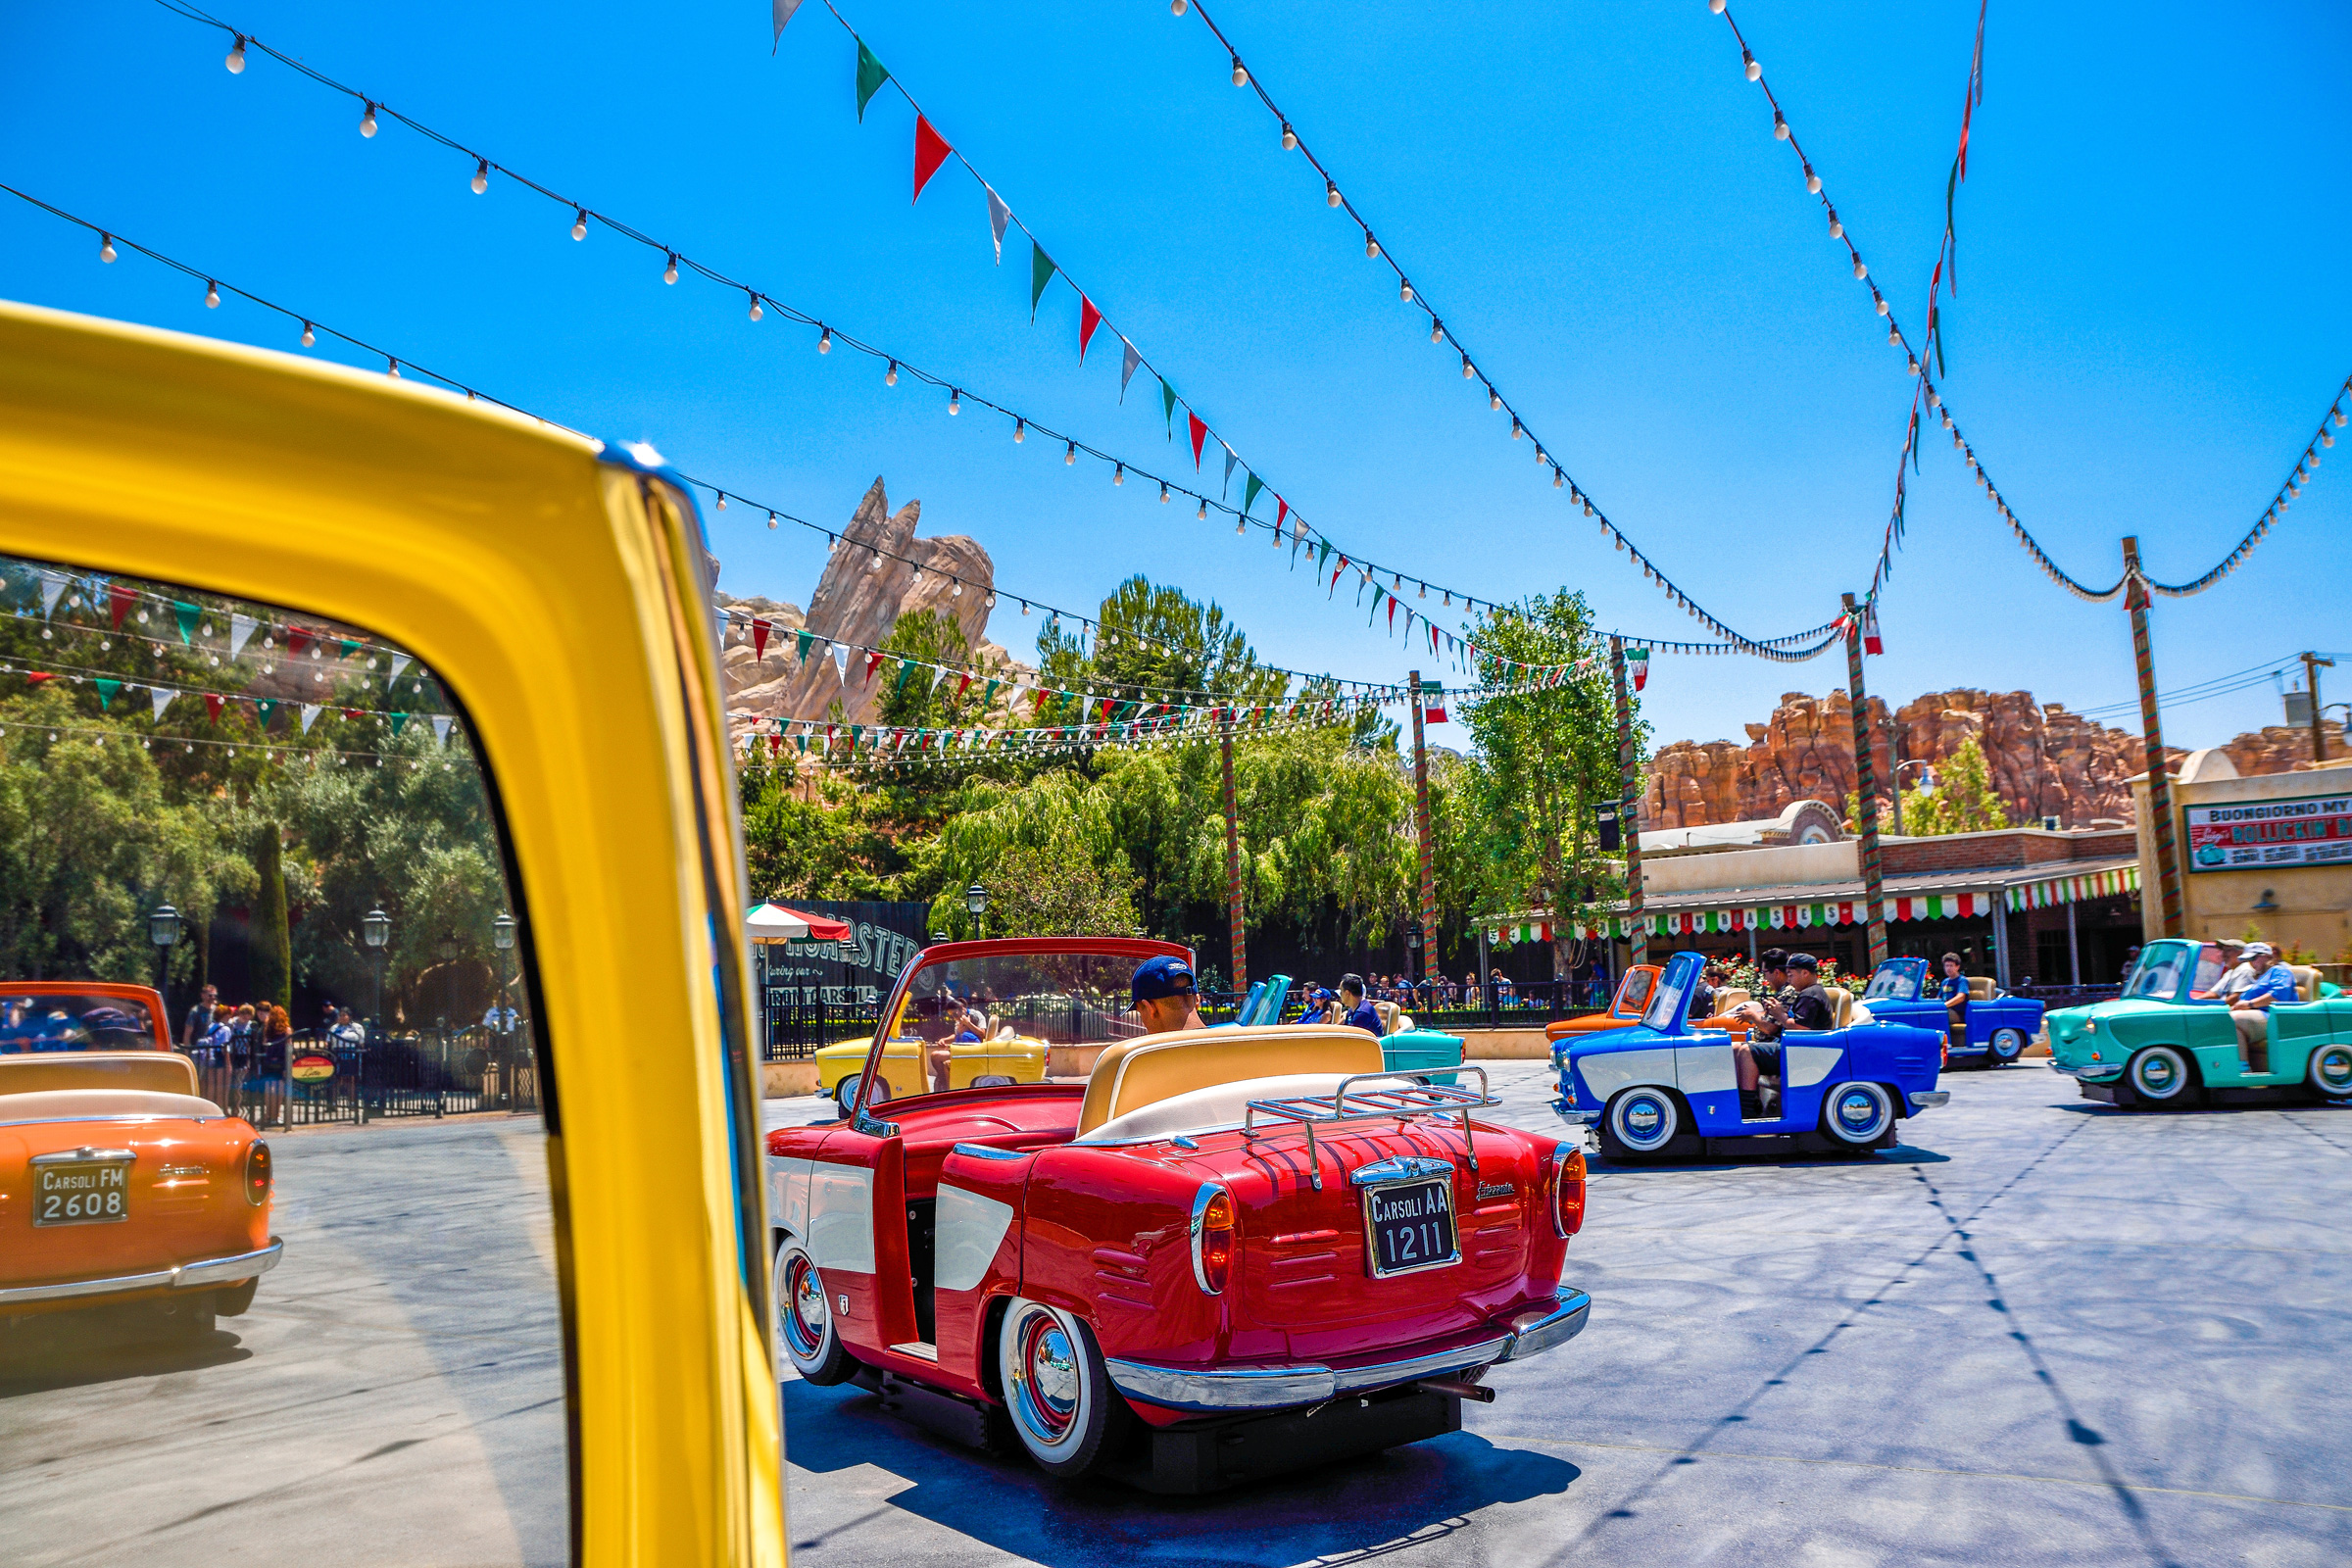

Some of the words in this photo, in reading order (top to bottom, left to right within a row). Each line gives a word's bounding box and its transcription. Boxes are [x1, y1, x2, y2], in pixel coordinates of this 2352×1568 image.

[2209, 804, 2318, 823] BUONGIORNO
[2322, 800, 2350, 813] MY
[2232, 819, 2332, 844] ROLLICKIN'
[43, 1171, 95, 1191] CARSOLI
[100, 1167, 123, 1188] FM
[43, 1191, 122, 1218] 2608
[1372, 1195, 1422, 1223] CARSOLI
[1426, 1186, 1448, 1215] AA
[1386, 1221, 1443, 1262] 1211
